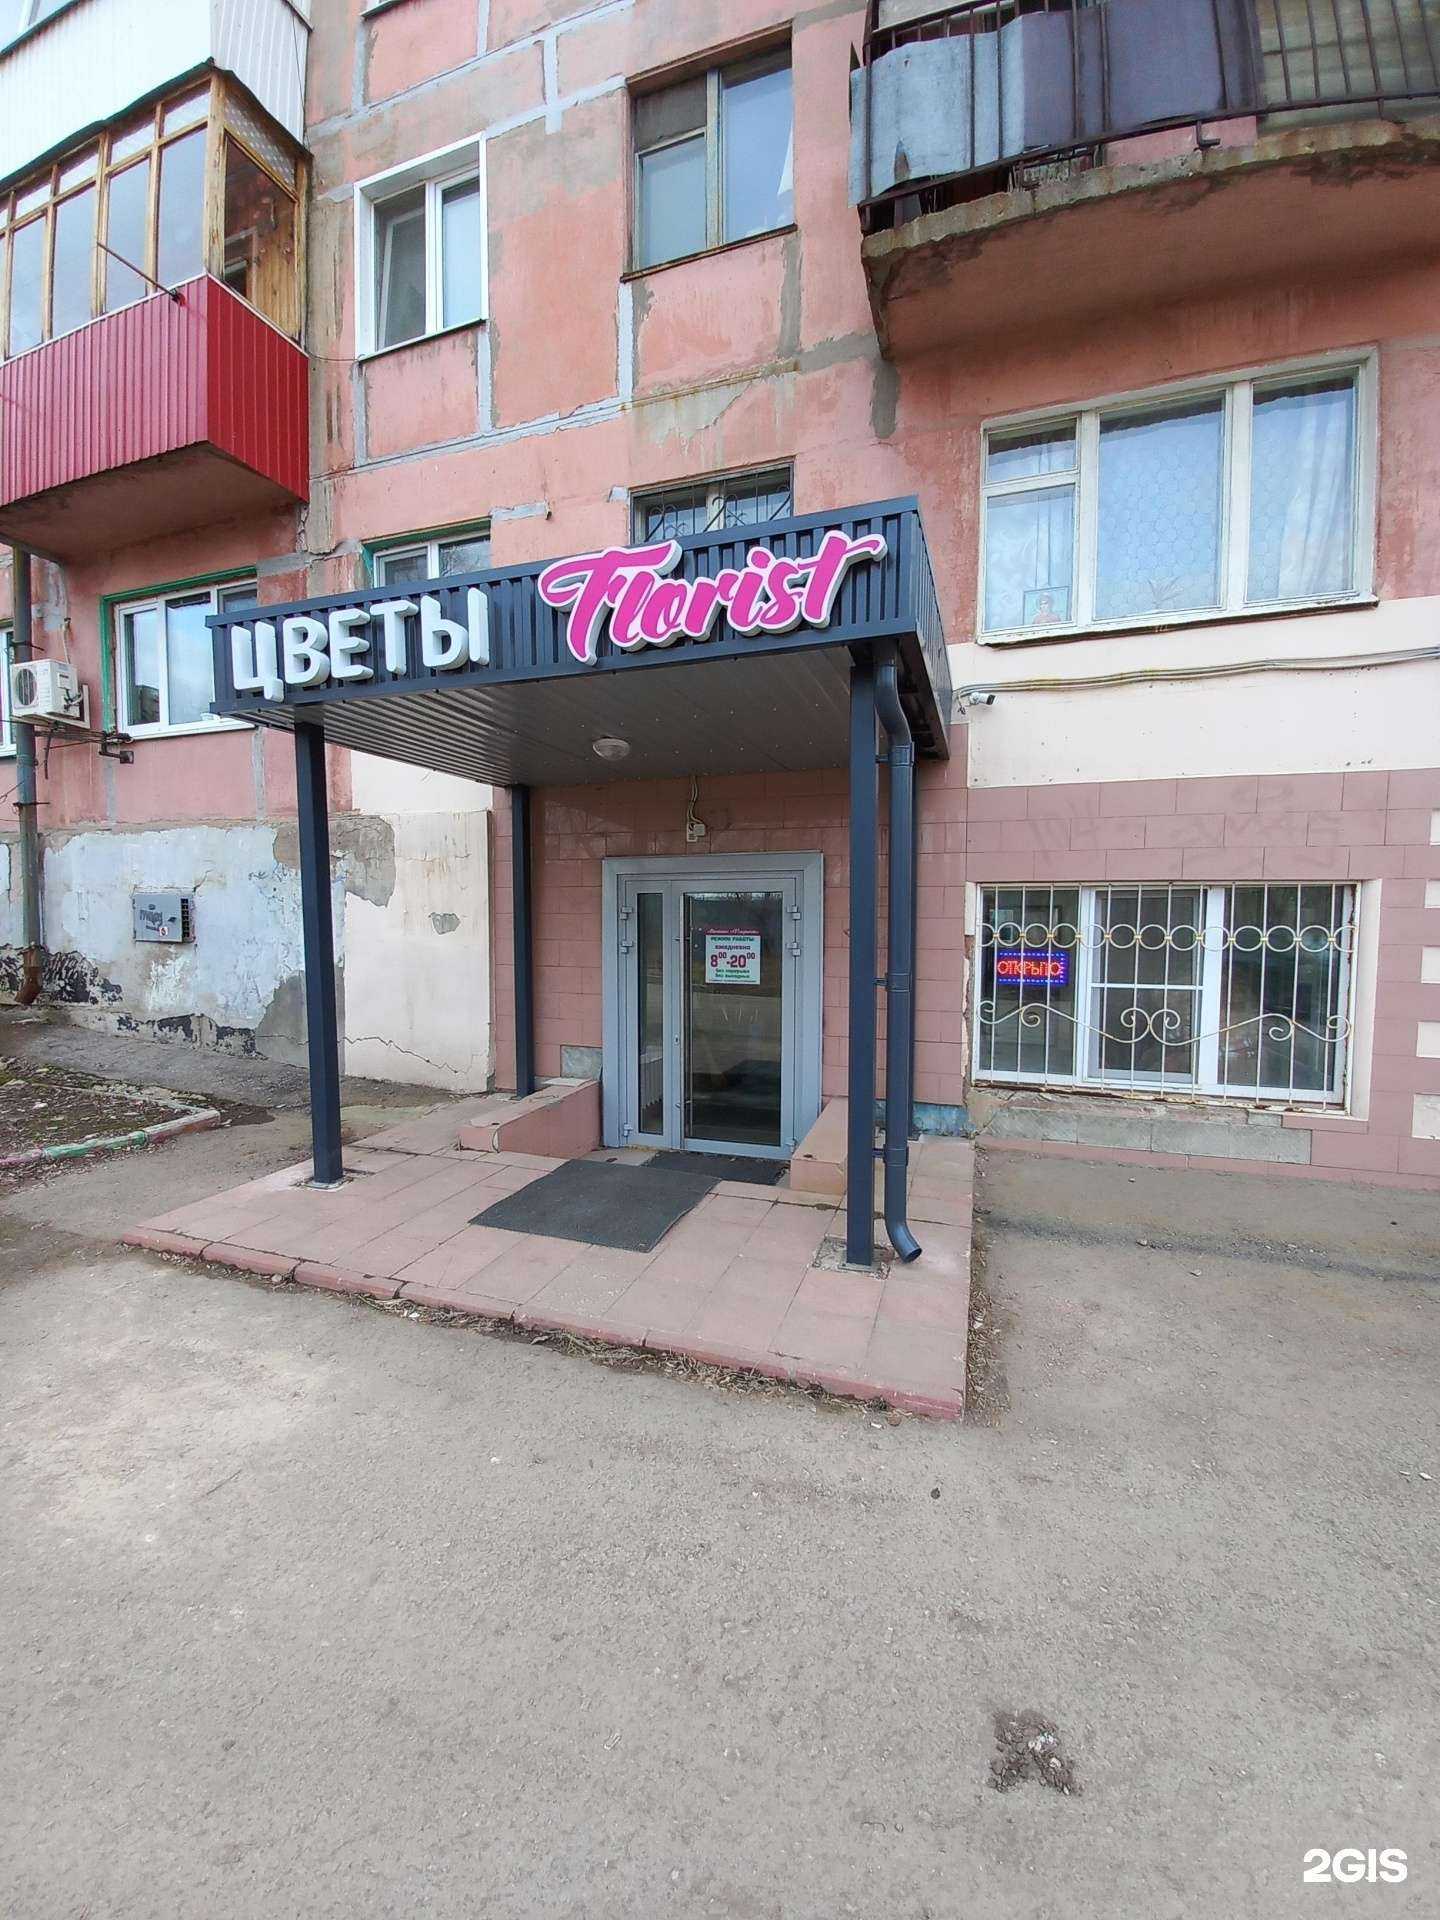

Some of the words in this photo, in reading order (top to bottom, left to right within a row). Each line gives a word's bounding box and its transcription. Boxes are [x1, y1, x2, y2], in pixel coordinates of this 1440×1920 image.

[231, 587, 490, 702] ЦВЕТЫ
[537, 530, 888, 665] Florist
[997, 960, 1061, 976] ОТКРЫТО
